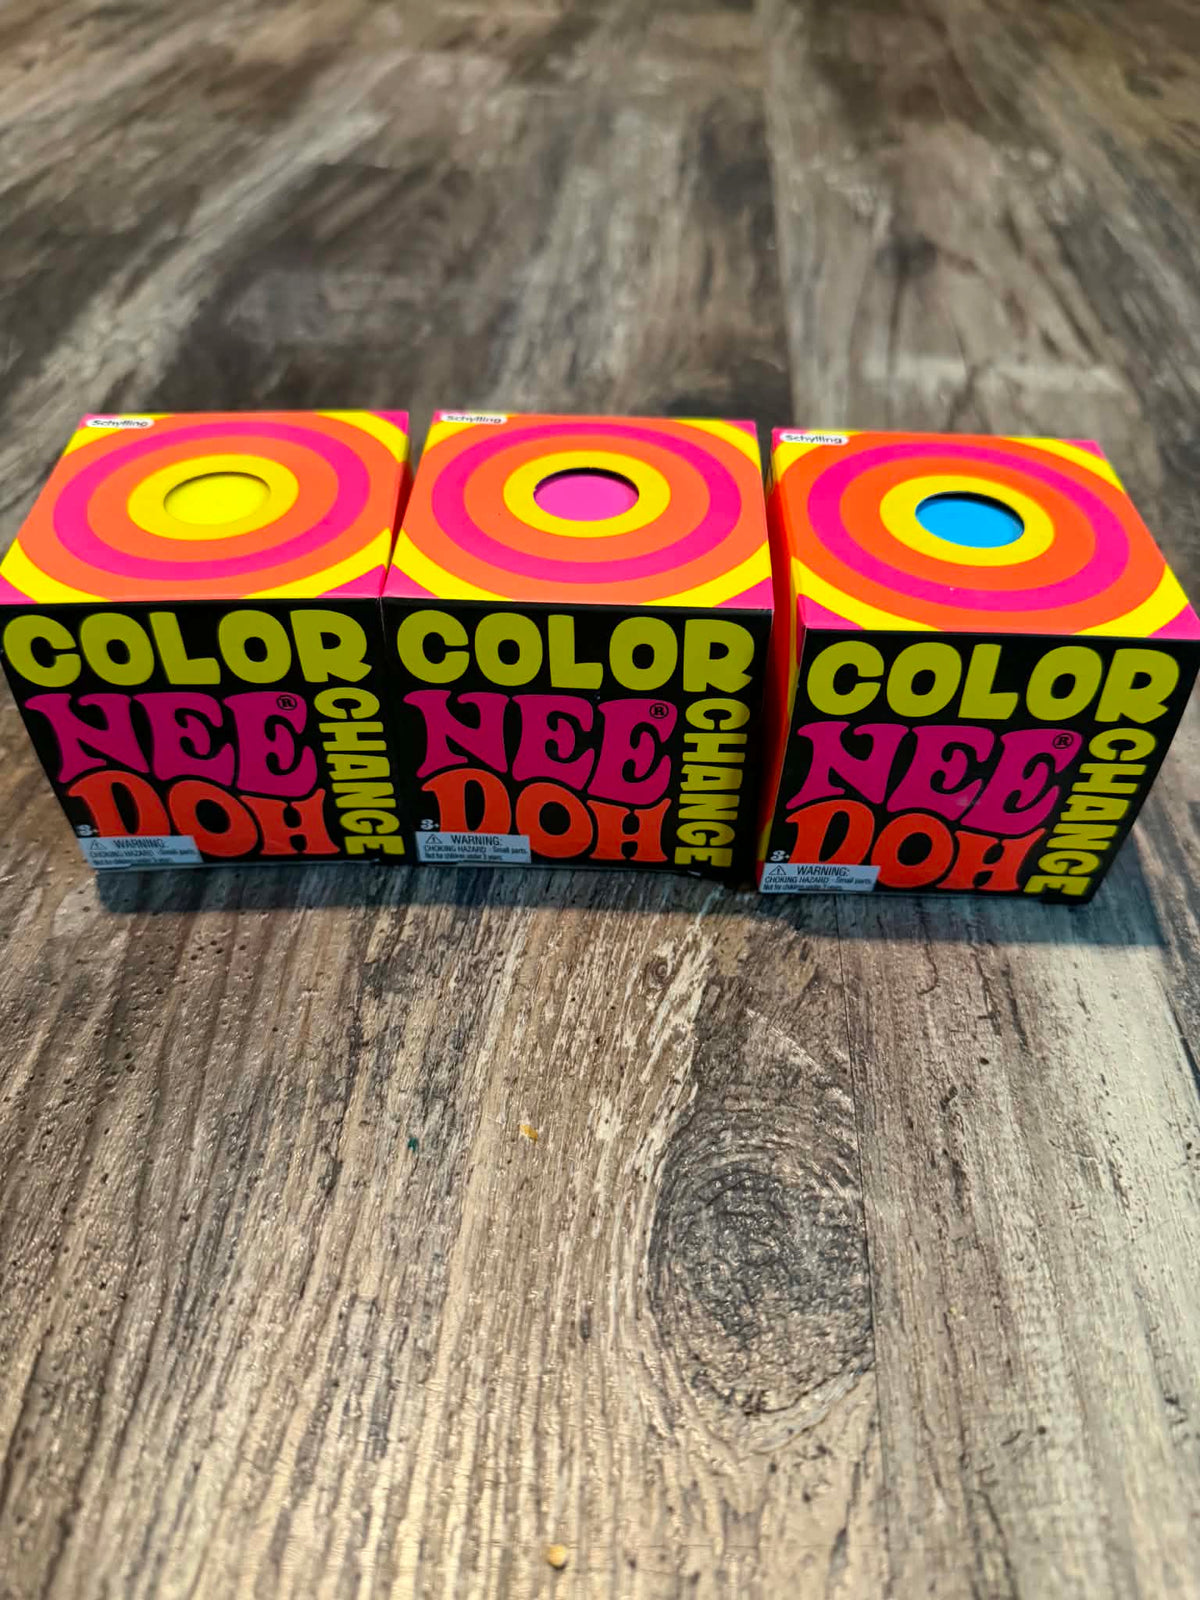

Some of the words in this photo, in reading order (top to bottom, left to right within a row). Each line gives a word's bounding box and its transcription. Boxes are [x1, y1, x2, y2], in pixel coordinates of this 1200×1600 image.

[785, 434, 843, 444] Schylling
[3, 610, 371, 687] COLOR
[397, 610, 754, 693] COLOR
[807, 641, 1179, 723] COLOR
[314, 687, 404, 854] CHANGE
[675, 698, 749, 865] CHANGE
[1025, 728, 1155, 895] CHANGE
[68, 770, 339, 856] DOH
[421, 768, 671, 862] DOH
[787, 800, 1046, 891] DOH
[770, 850, 790, 861] 3+
[796, 865, 850, 877] WARNING:
